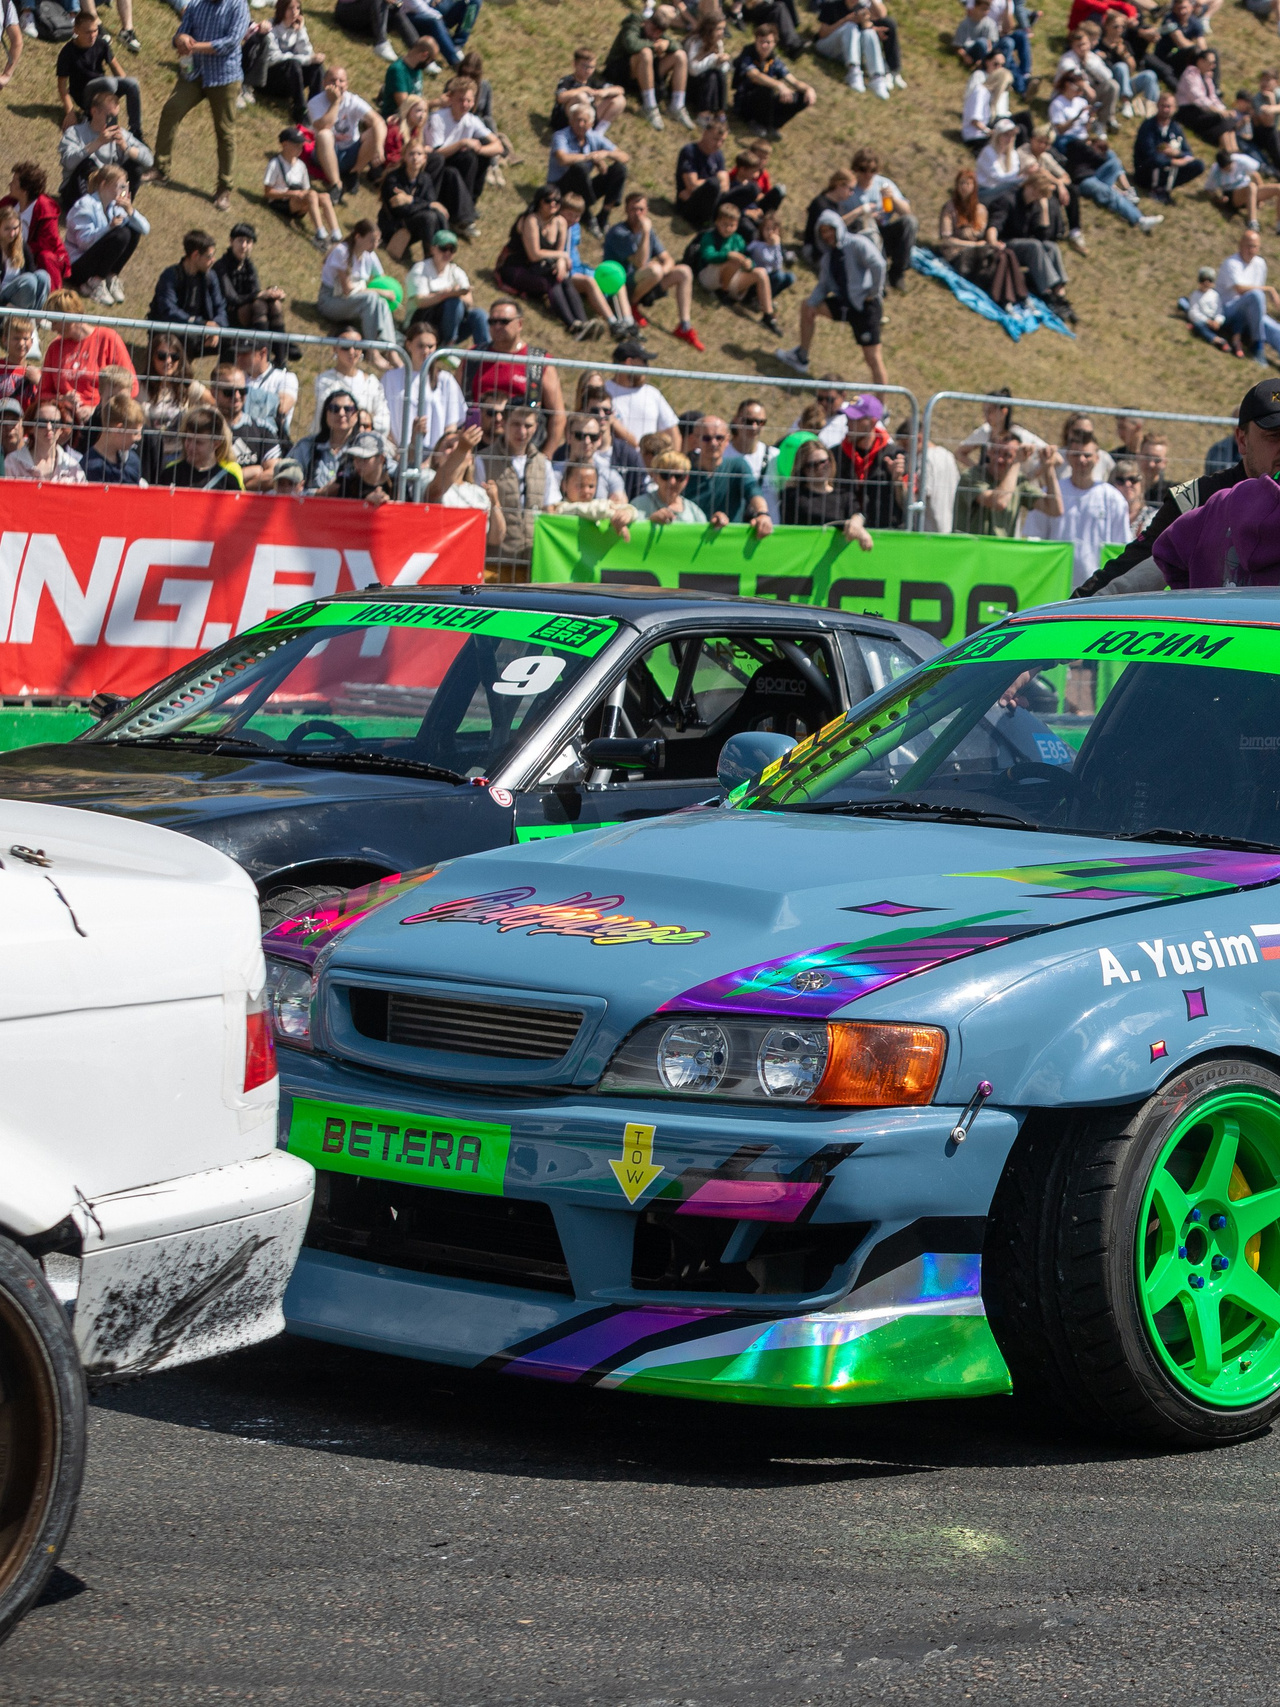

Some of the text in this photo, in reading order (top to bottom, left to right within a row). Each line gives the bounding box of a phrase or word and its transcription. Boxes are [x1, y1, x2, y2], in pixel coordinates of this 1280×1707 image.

[552, 616, 602, 635] BET
[960, 635, 1004, 658] 93
[1083, 630, 1234, 660] ЮСИМ
[492, 655, 567, 696] 9
[1038, 738, 1069, 761] E85
[1099, 931, 1258, 986] A. Yusim
[321, 1116, 482, 1174] BET.ERA
[626, 1130, 646, 1184] TOW
